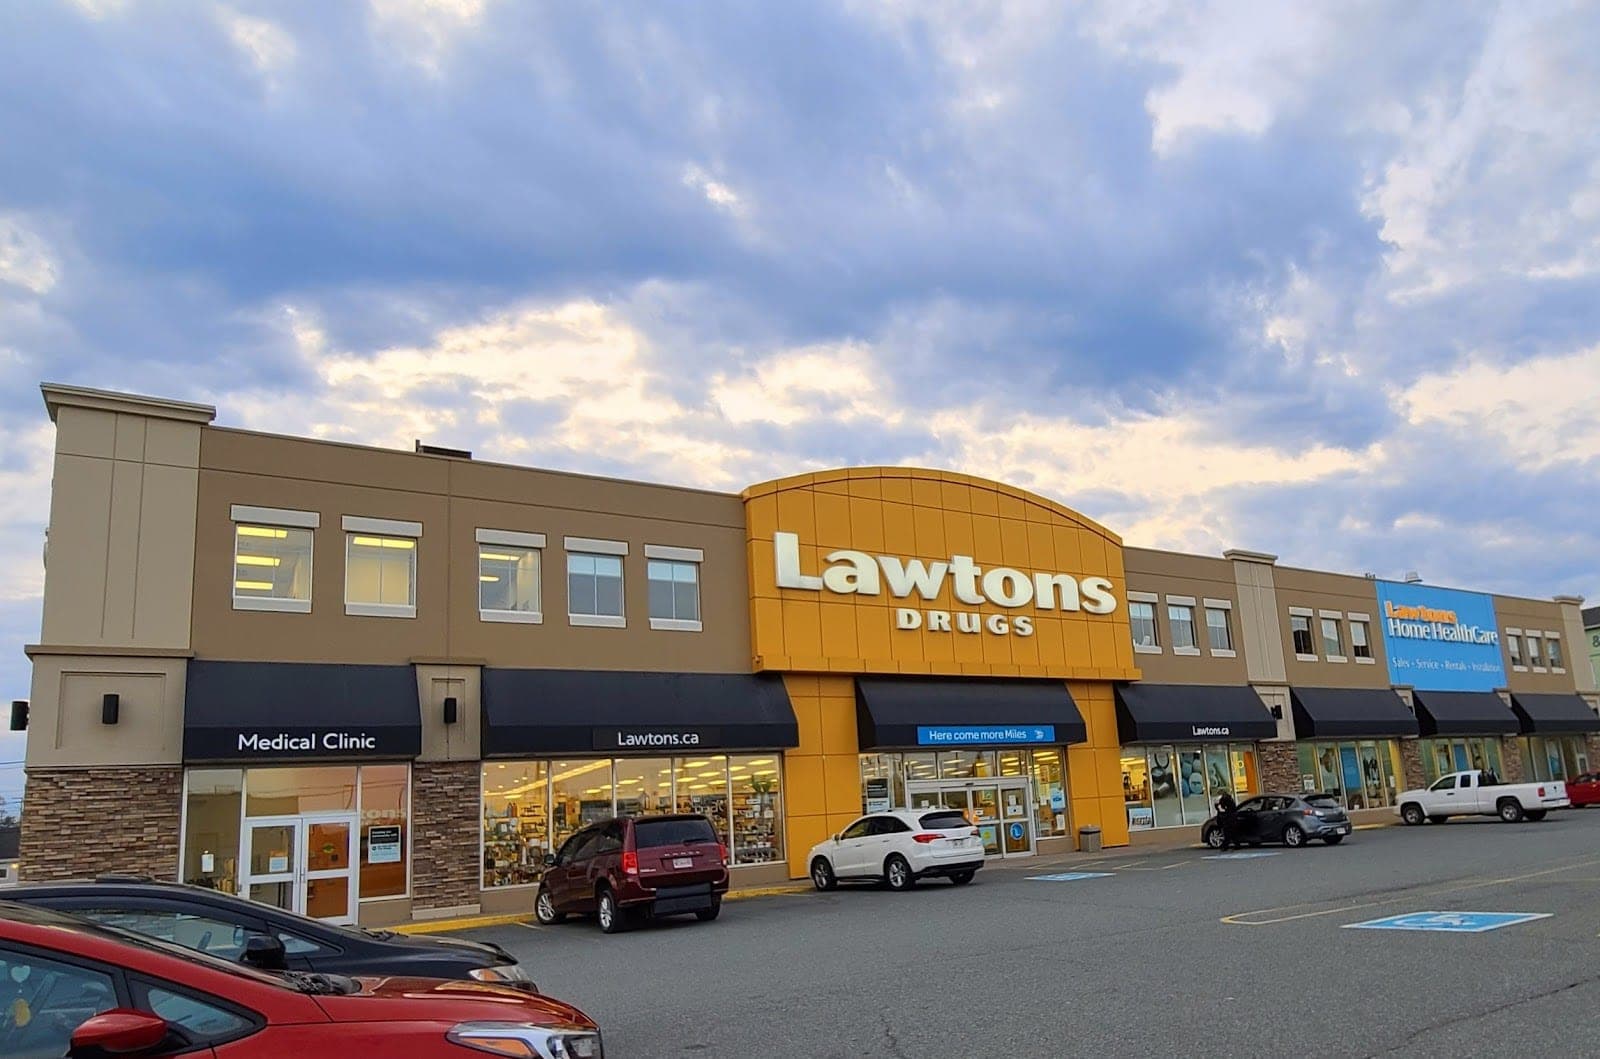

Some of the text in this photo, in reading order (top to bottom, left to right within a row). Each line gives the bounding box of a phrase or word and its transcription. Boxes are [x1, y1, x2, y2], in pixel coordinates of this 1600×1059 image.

[774, 531, 1117, 614] Lawtons
[1384, 600, 1457, 624] Lawtons
[896, 608, 1034, 636] DRUGS
[1387, 618, 1499, 645] Home HealthCare
[1392, 657, 1410, 668] Sales
[1416, 658, 1439, 669] Service
[618, 731, 700, 746] Lawtons.ca
[929, 728, 1027, 740] Here come more Miles
[1192, 725, 1229, 736] Lawtons.ca
[238, 733, 376, 750] Medical Clinic
